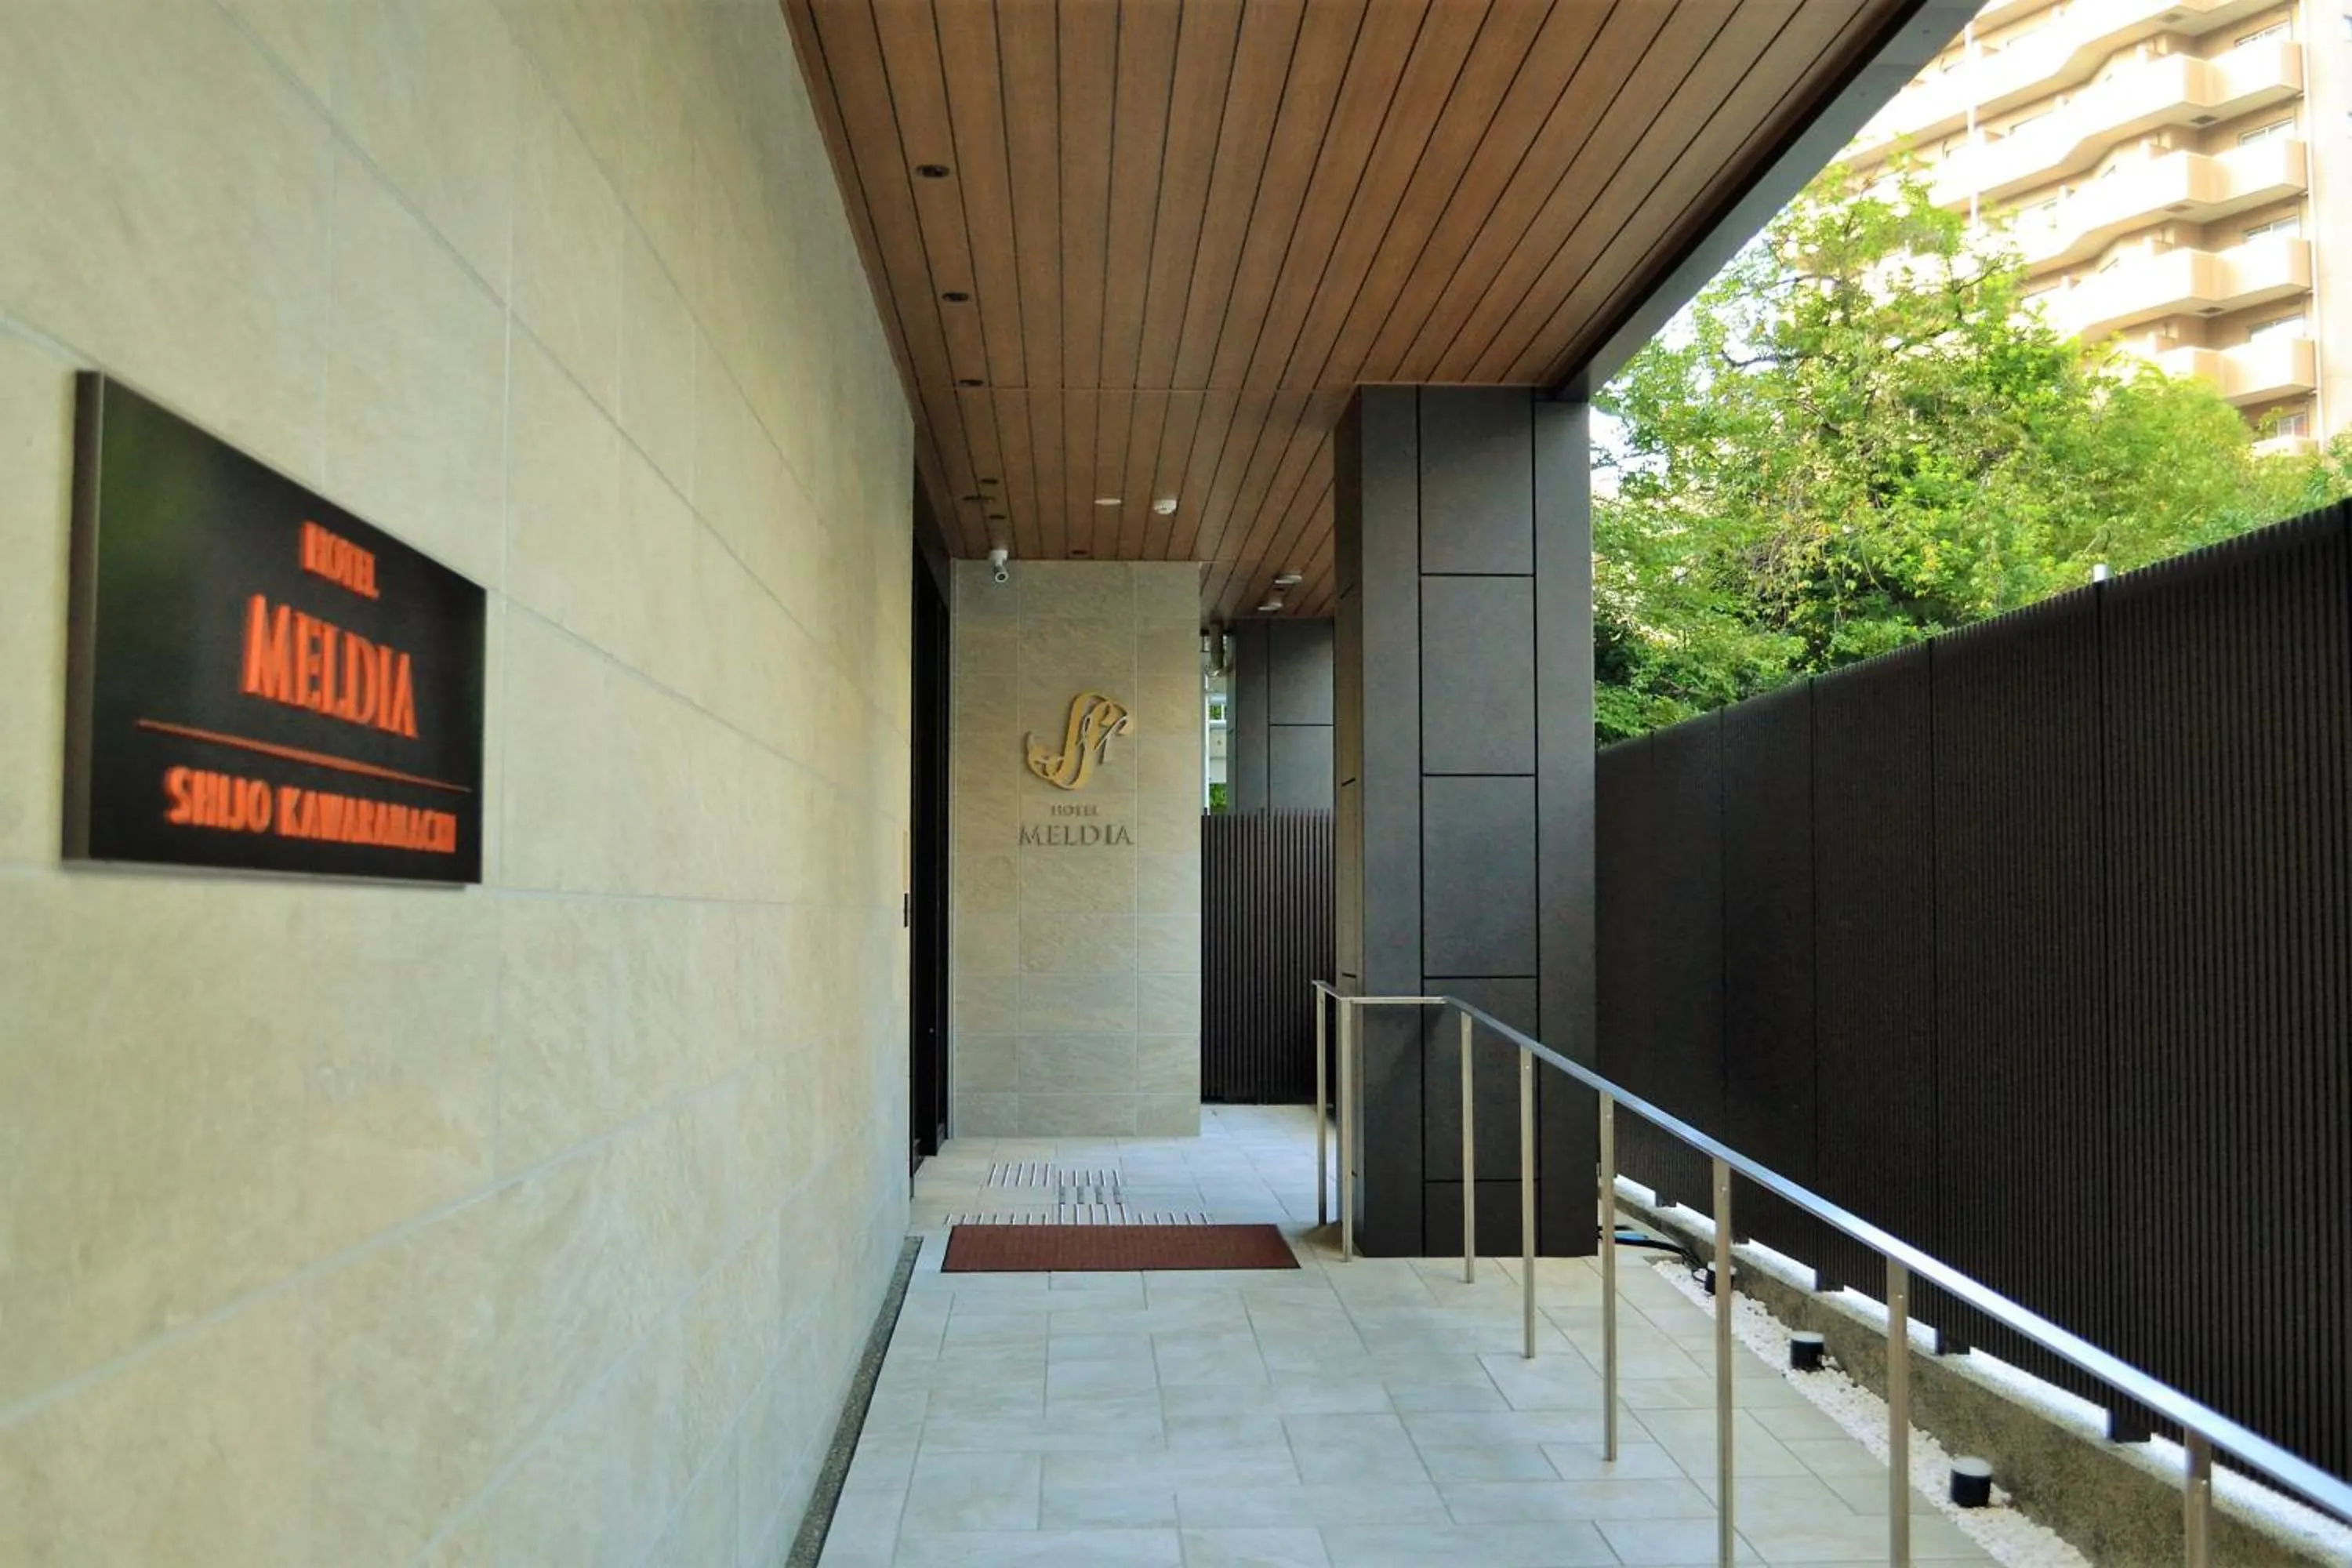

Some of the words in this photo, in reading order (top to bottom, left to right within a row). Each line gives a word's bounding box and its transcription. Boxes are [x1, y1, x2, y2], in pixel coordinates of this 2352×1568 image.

[299, 521, 379, 599] HOTEL
[241, 593, 418, 739] MELDIA
[165, 766, 271, 833] SHIJO
[1051, 804, 1100, 817] HOTEL
[1018, 824, 1134, 846] MELDIA
